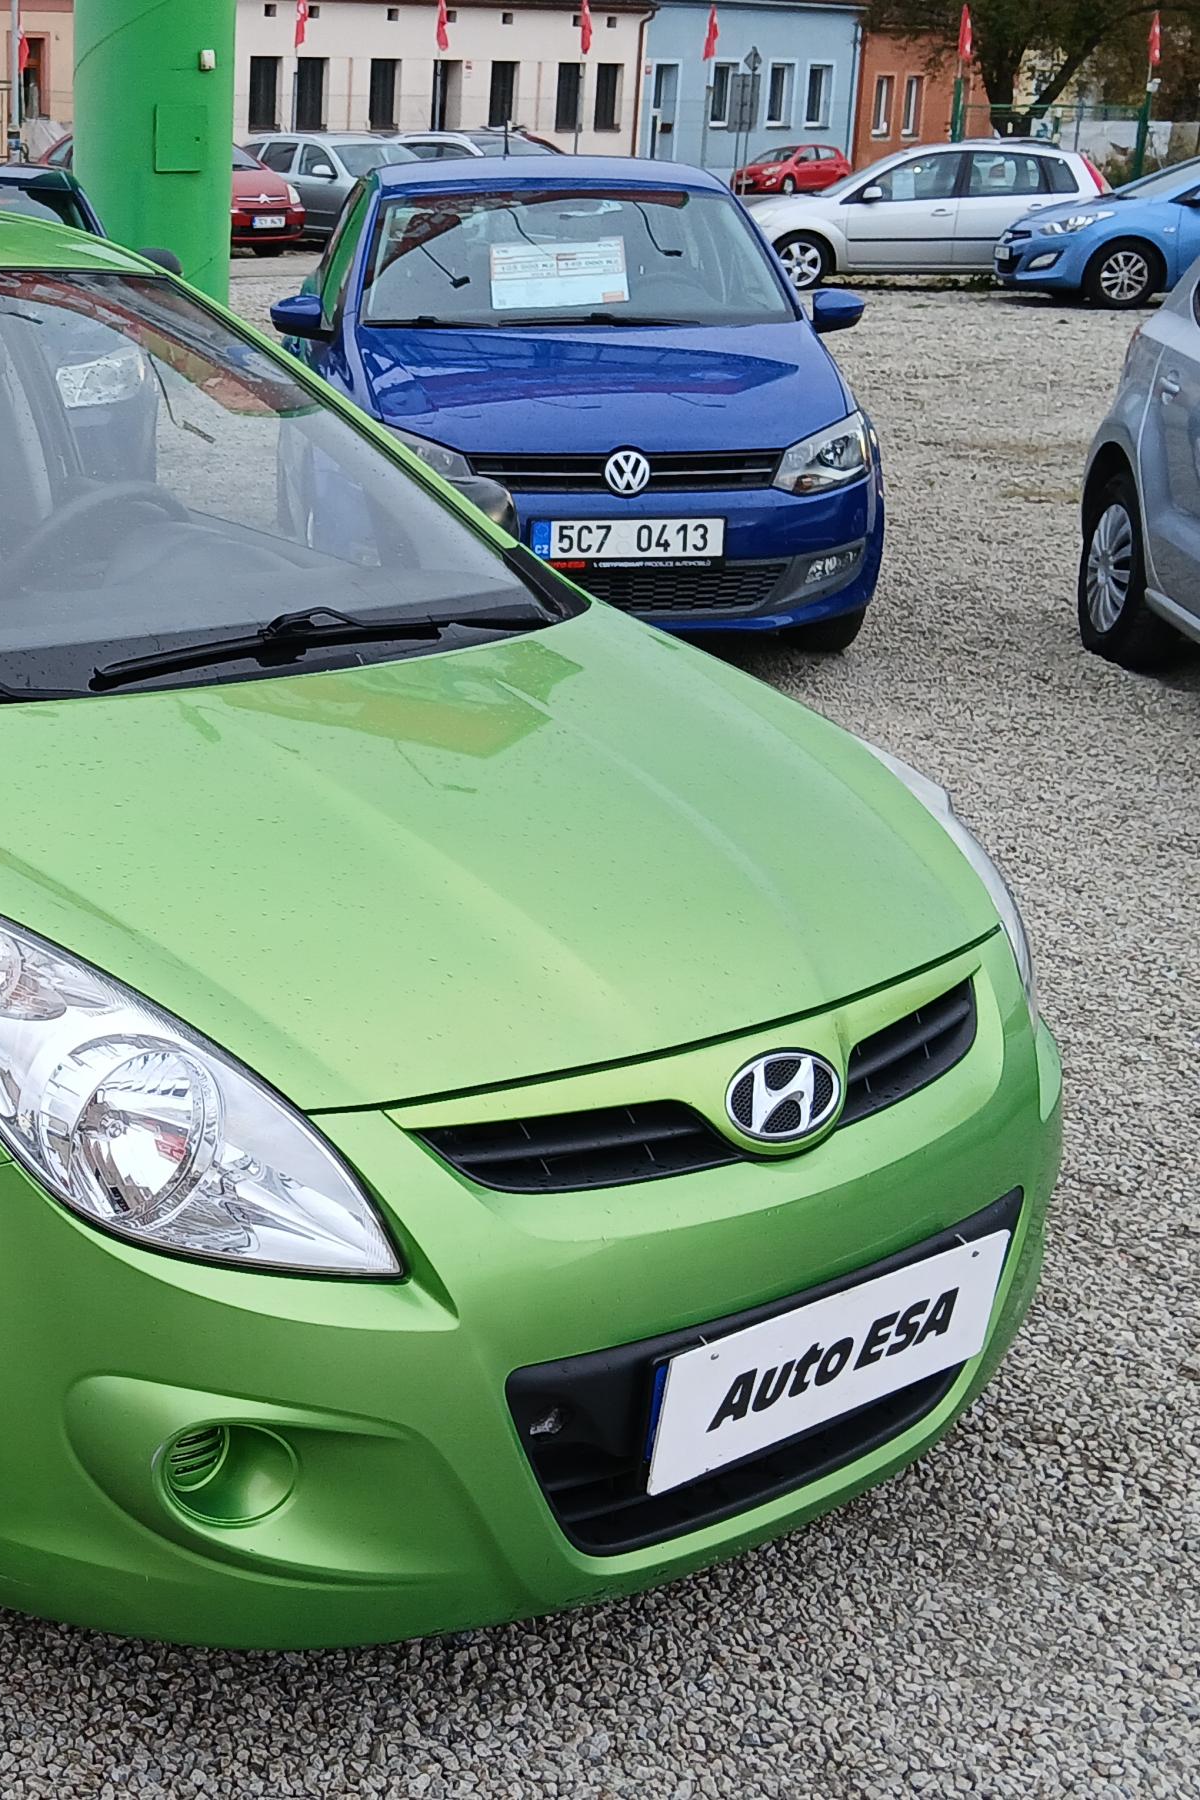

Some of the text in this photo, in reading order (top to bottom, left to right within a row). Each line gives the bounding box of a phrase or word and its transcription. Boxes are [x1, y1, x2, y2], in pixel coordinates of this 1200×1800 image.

[535, 544, 549, 555] CZ
[558, 524, 708, 553] 5C7 0413
[706, 1287, 960, 1433] Auto ESA
